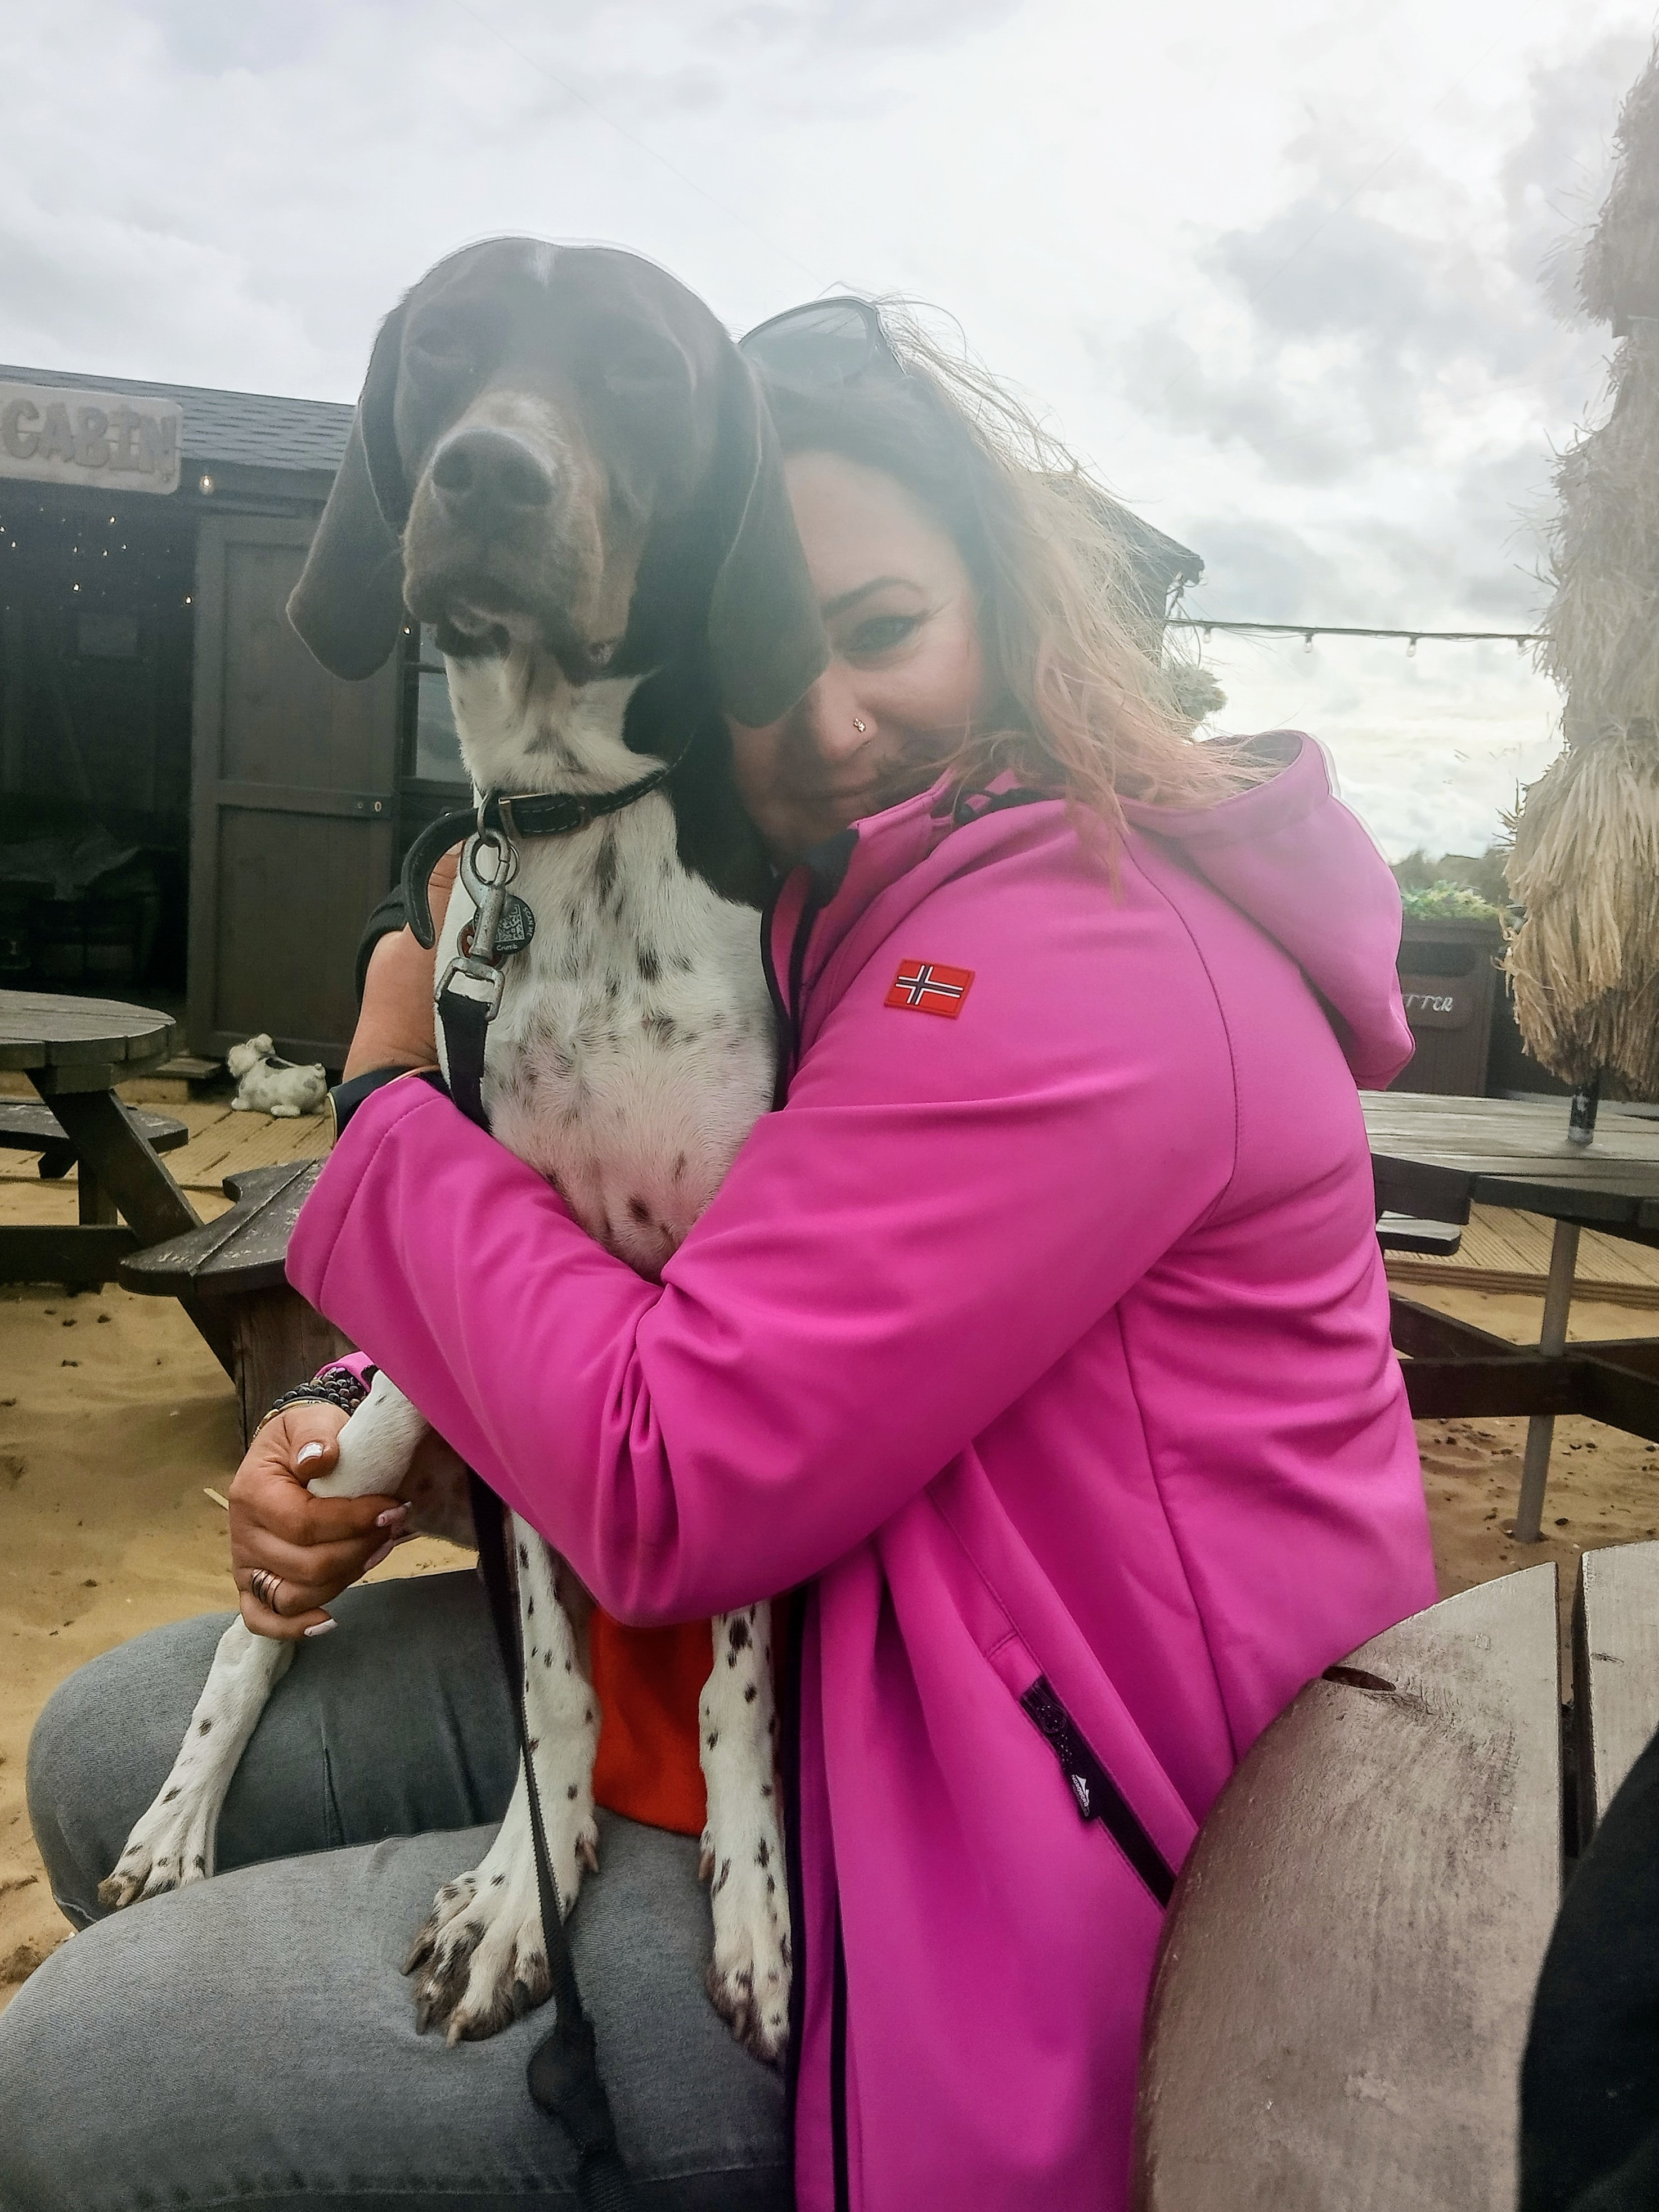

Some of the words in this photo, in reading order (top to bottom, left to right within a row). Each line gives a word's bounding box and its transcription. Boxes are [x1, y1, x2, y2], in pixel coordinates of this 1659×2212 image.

[2, 398, 176, 474] CABIN
[523, 907, 534, 925] SCAN
[527, 927, 534, 937] ME
[1403, 994, 1453, 1012] TTER
